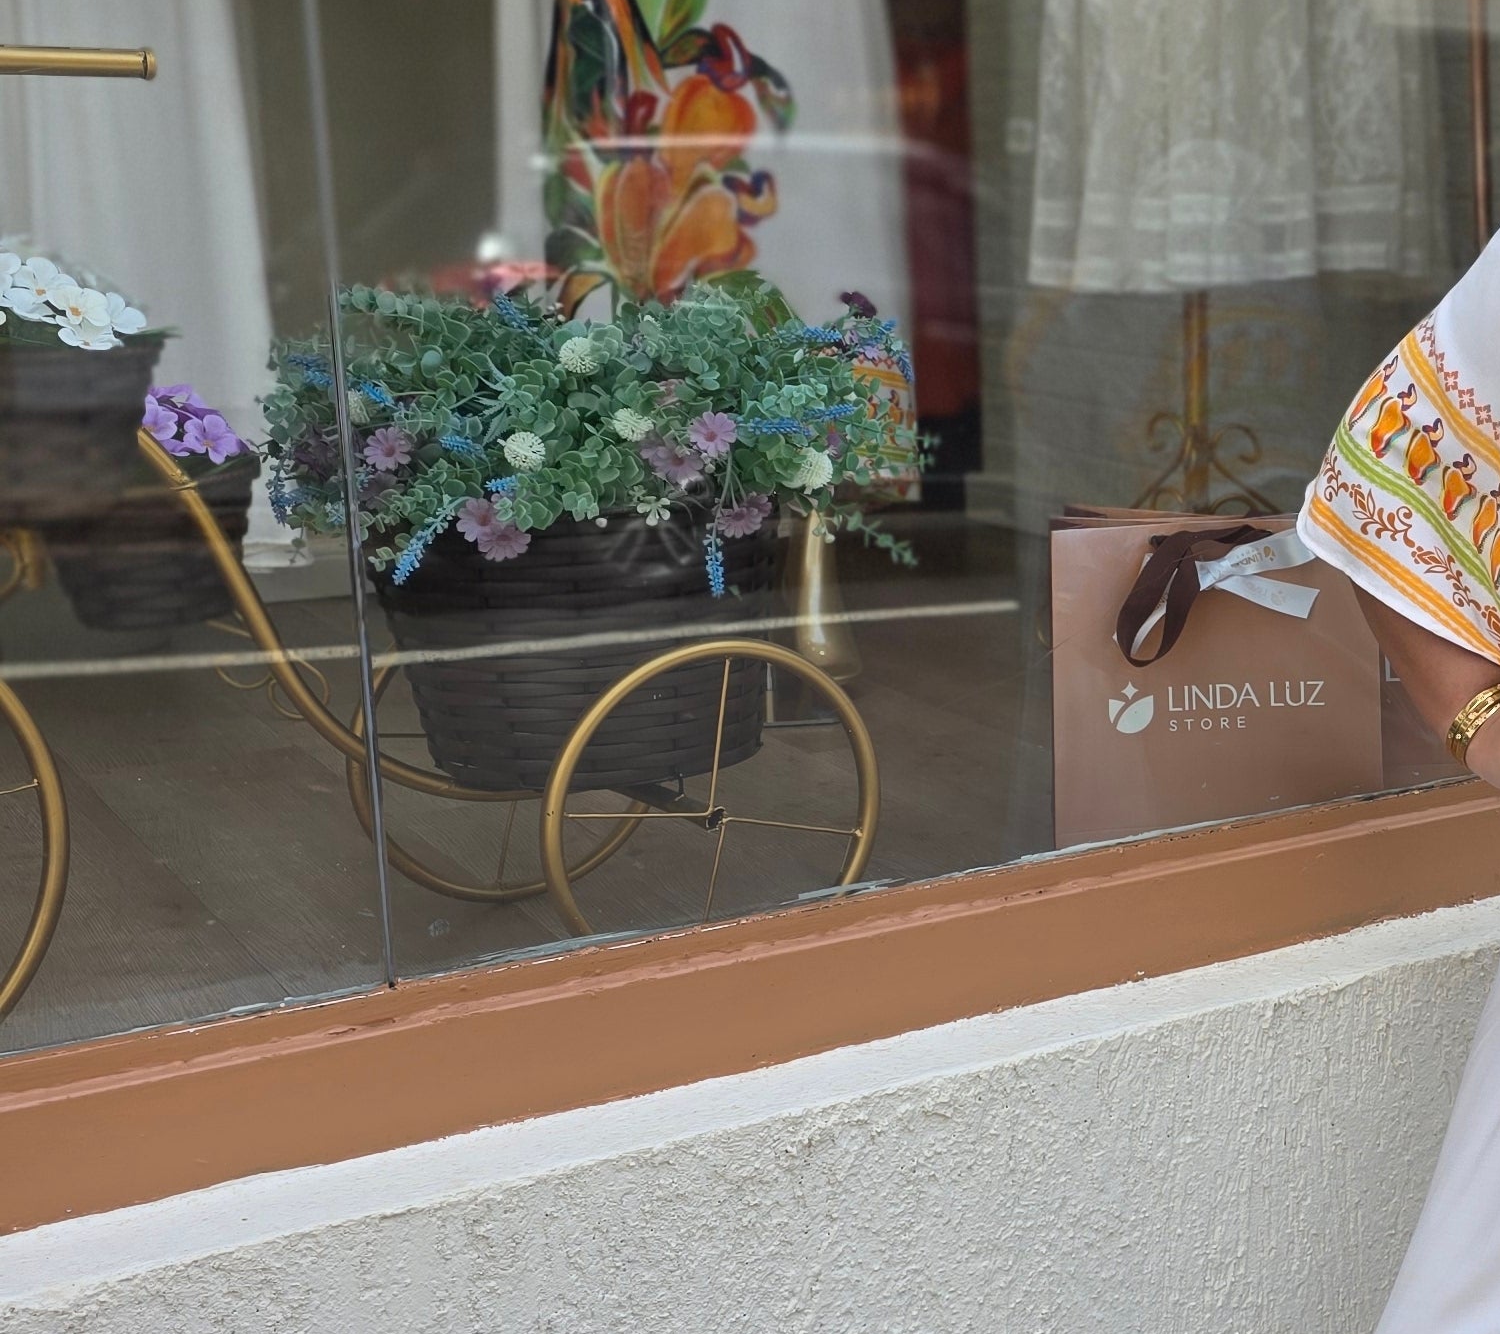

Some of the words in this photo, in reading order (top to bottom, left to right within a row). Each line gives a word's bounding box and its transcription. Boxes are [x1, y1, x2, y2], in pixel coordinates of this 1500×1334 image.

[1167, 682, 1261, 712] LINDA
[1269, 680, 1326, 708] LUZ
[1168, 715, 1247, 732] STORE
